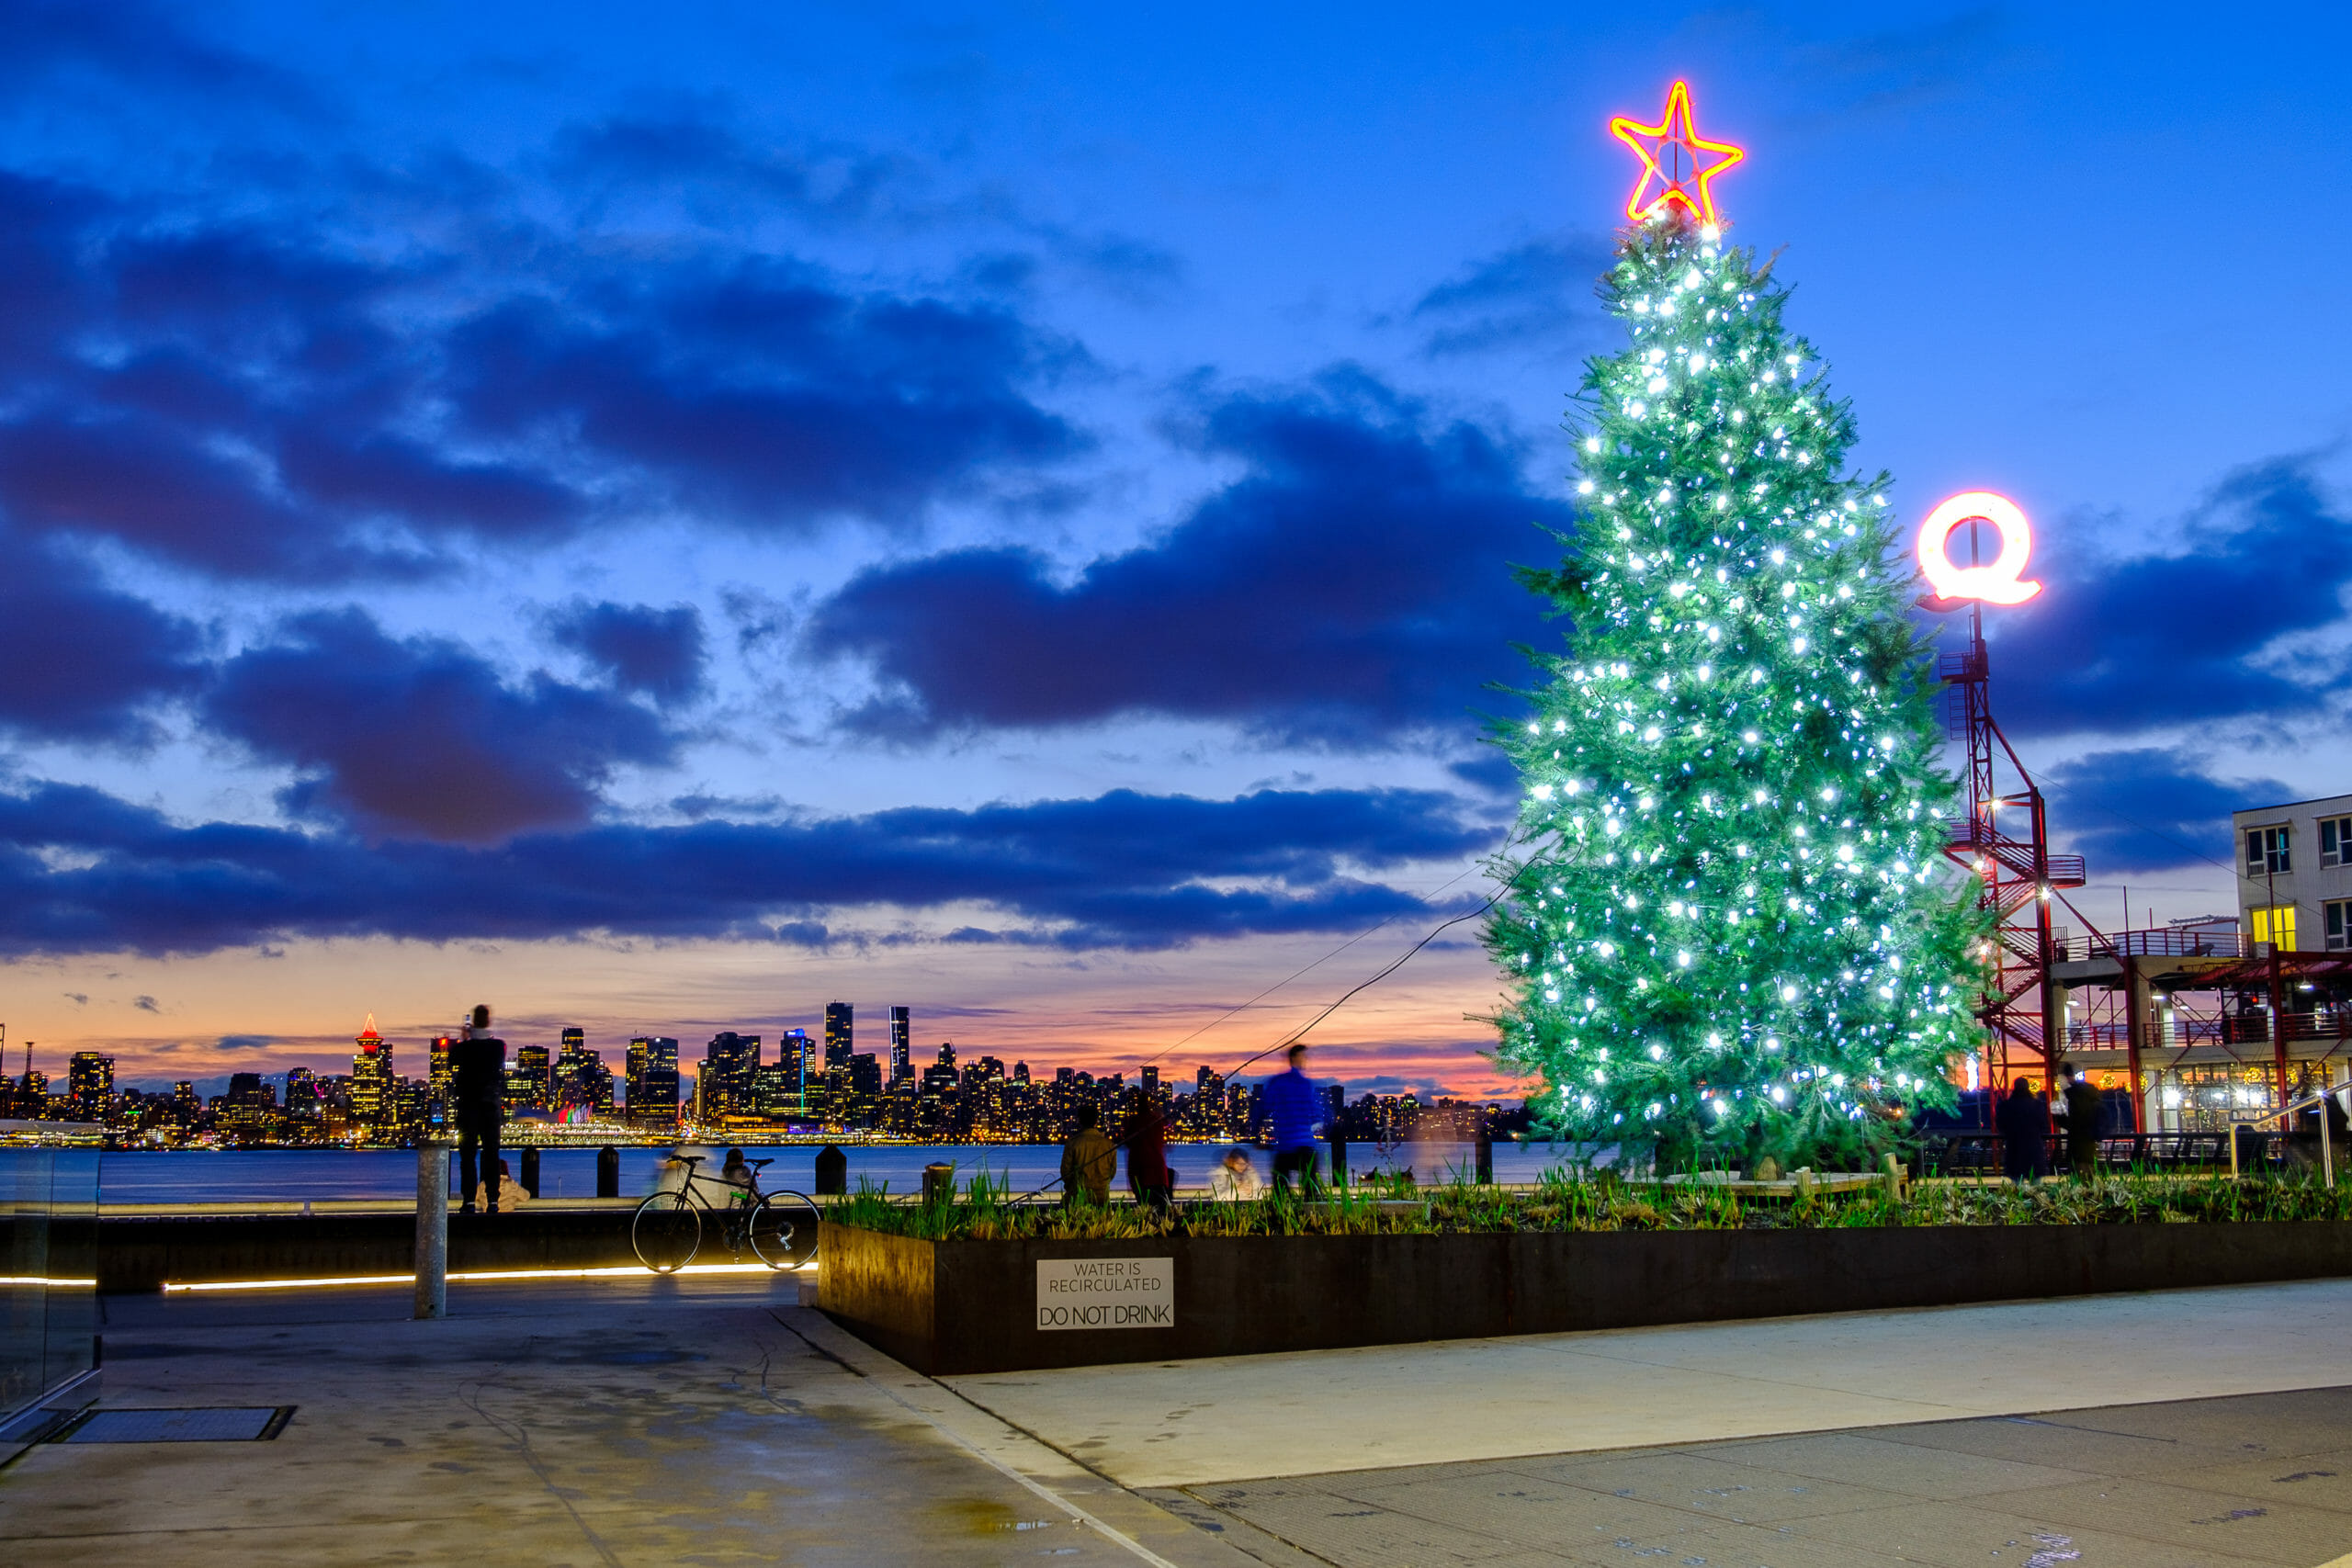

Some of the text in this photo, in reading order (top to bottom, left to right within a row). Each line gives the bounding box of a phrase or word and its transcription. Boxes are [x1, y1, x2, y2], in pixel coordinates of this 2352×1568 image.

[1917, 491, 2043, 606] Q
[1074, 1262, 1141, 1276] WATER IS
[1049, 1278, 1161, 1292] RECIRCULATED
[1040, 1304, 1170, 1325] DO NOT DRINK
